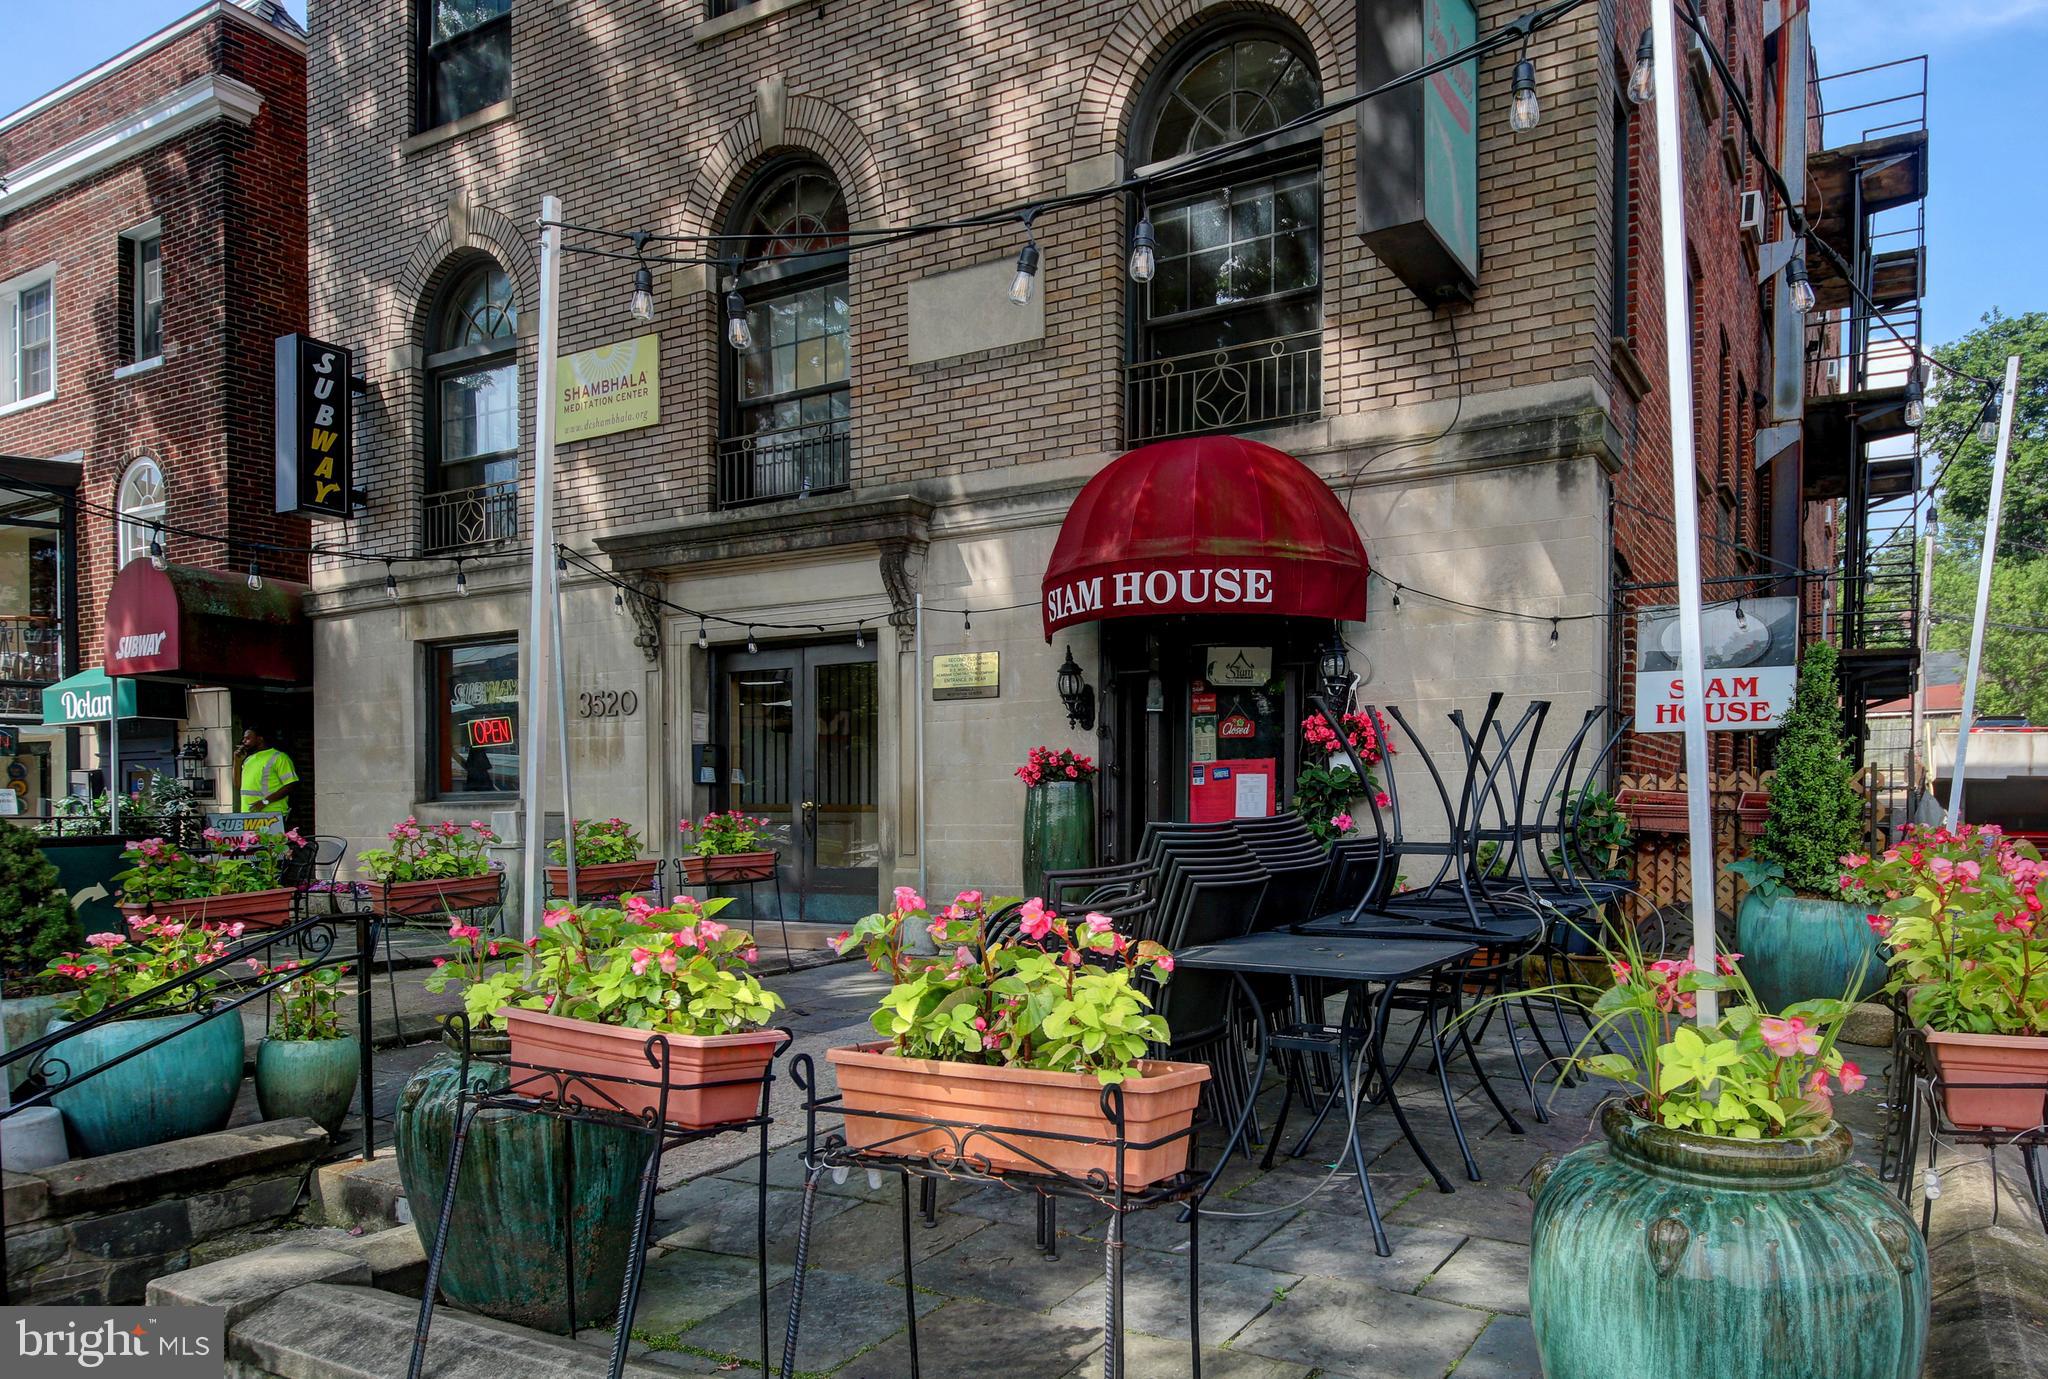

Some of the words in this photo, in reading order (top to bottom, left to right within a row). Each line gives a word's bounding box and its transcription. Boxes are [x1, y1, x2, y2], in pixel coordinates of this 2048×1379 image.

[563, 370, 648, 402] SHAMBHALA
[563, 396, 613, 414] MEDITATION
[615, 387, 649, 403] CENTER
[312, 353, 341, 503] SUBWAY
[564, 410, 649, 434] www.dcshambhala.org
[1047, 576, 1104, 623] SIAM
[1112, 568, 1273, 607] HOUSE
[115, 630, 167, 660] SUBWAY
[450, 679, 519, 706] SUBWAY
[1669, 676, 1760, 700] SAM
[61, 690, 112, 720] Dolan
[578, 689, 638, 718] 3520
[474, 720, 510, 744] OPEN
[1222, 722, 1250, 736] Closed
[217, 816, 279, 832] SUBWAY
